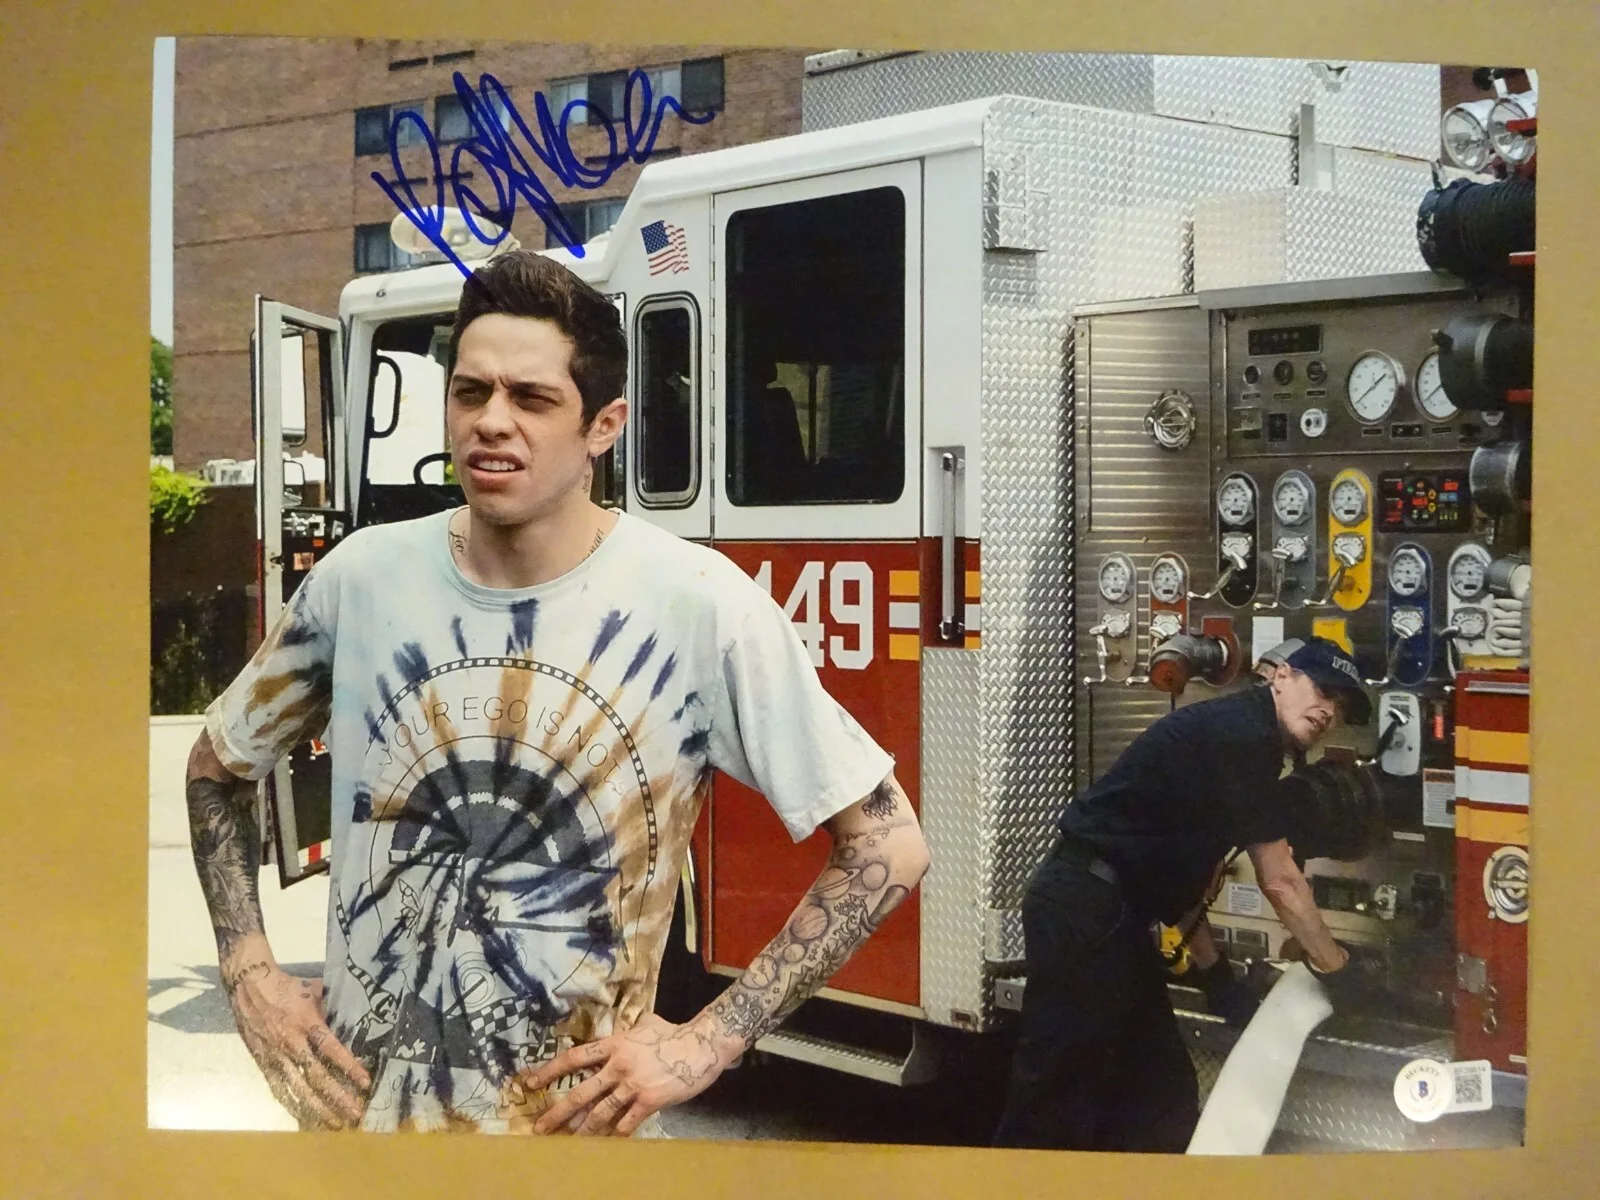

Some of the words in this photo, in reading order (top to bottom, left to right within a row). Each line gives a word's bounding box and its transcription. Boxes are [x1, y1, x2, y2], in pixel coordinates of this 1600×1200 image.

[379, 701, 452, 766] YOUR
[463, 696, 528, 724] EGO
[536, 706, 565, 736] IS
[567, 725, 622, 783] NOT
